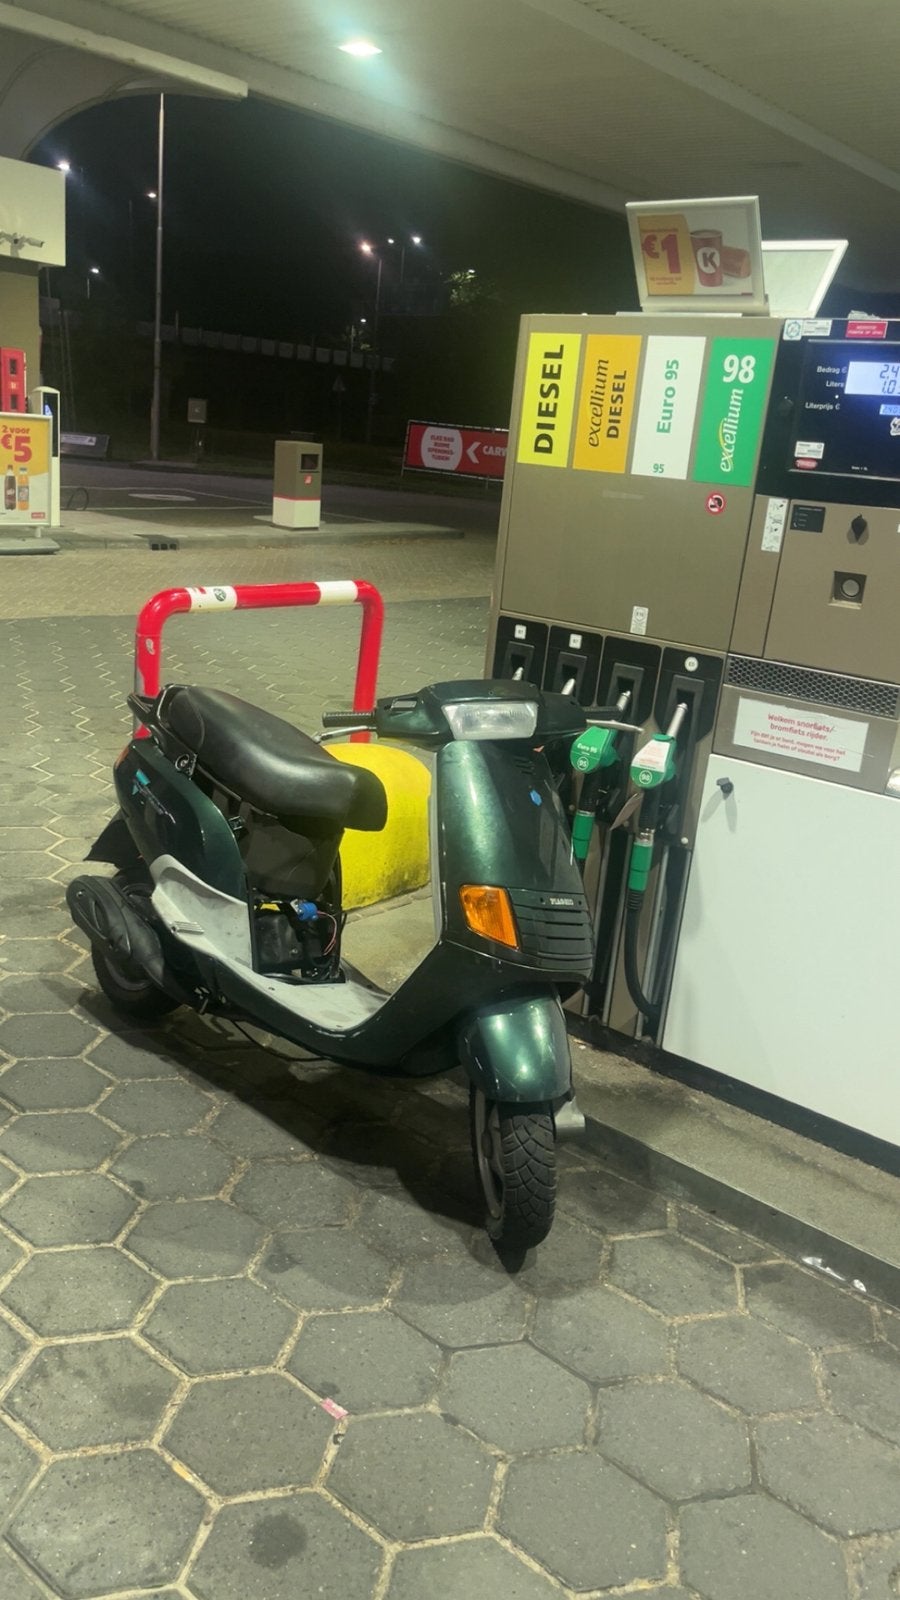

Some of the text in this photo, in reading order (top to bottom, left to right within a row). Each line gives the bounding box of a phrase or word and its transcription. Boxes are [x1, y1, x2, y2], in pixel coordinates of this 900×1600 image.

[641, 233, 681, 274] €1
[702, 252, 717, 269] K
[722, 354, 756, 384] 98
[816, 365, 840, 374] Bedrag
[534, 344, 564, 454] DIESEL
[588, 359, 609, 448] excellium
[606, 370, 627, 439] DIESEL
[657, 360, 679, 434] Euro 95
[805, 402, 833, 410] Literprijs
[1, 425, 8, 433] 2
[719, 388, 744, 472] excellium
[1, 433, 32, 463] €5
[653, 463, 665, 474] 95
[768, 713, 835, 733] Welkom snorfiets/
[770, 723, 828, 741] bromfiets rijder.
[577, 743, 590, 751] Euro
